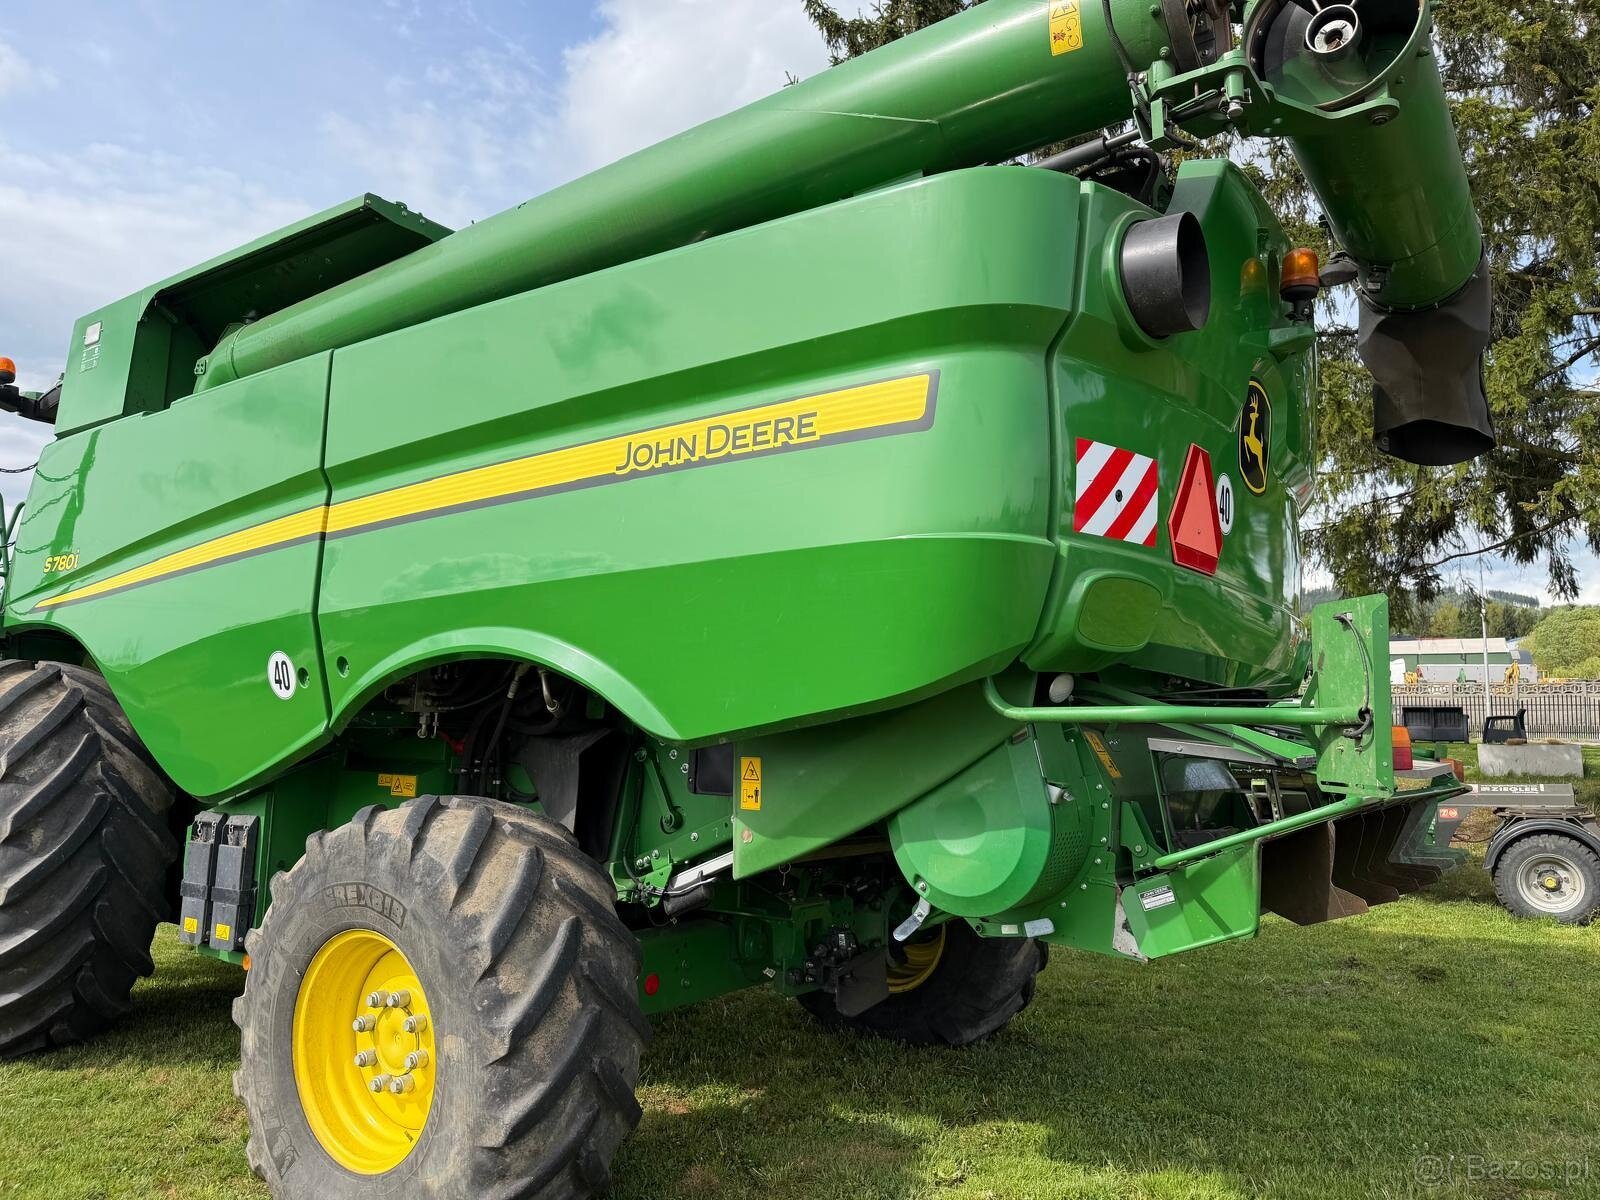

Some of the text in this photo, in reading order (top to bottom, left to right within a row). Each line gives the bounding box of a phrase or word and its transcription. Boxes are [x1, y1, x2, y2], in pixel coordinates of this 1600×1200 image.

[615, 411, 818, 472] JOHN DEERE
[1219, 485, 1231, 525] 40
[43, 549, 80, 573] S780i
[274, 660, 290, 691] 40
